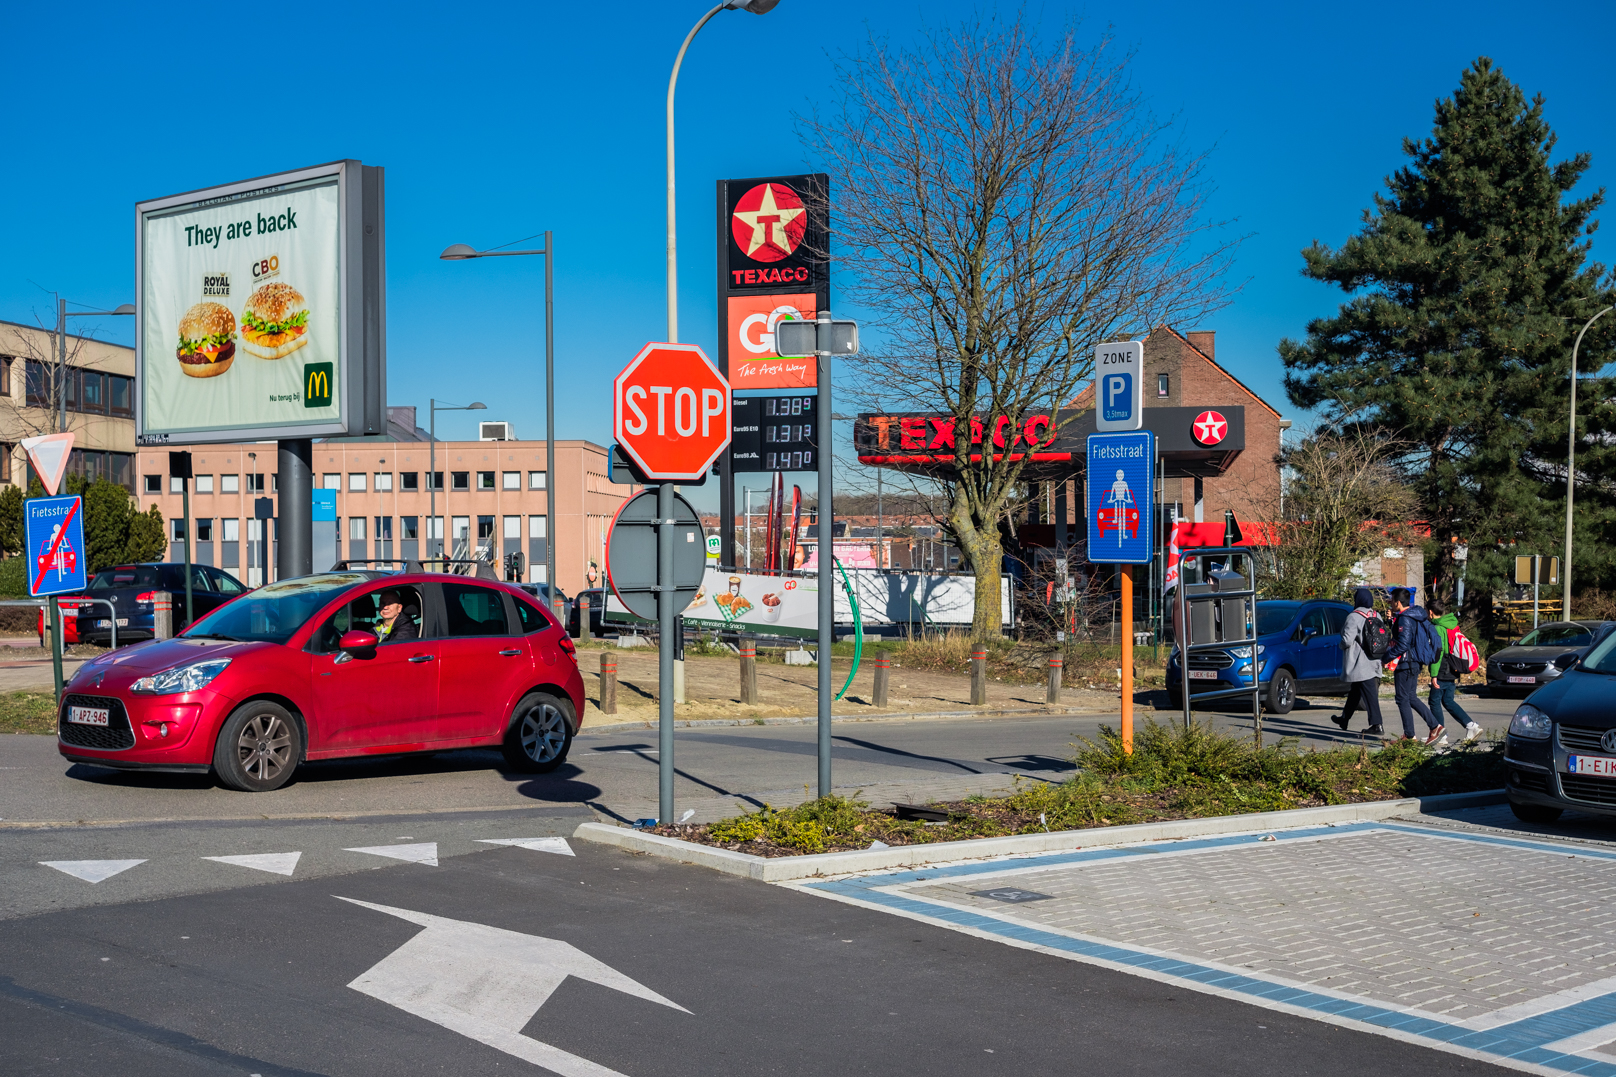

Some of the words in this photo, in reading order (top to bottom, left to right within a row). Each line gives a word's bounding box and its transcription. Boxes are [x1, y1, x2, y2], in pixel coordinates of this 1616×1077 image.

[184, 222, 222, 249] They
[226, 220, 252, 240] are
[257, 207, 297, 235] back
[252, 255, 279, 277] CBO
[204, 276, 230, 287] ROYAL
[732, 267, 809, 284] TEXACO
[203, 287, 230, 295] DELUXE
[1103, 351, 1133, 364] ZONE
[737, 363, 756, 377] The
[759, 363, 782, 375] fresh
[278, 394, 293, 402] terug
[1109, 376, 1126, 407] P
[624, 384, 724, 437] STOP
[868, 414, 1058, 450] TEXACO
[1093, 444, 1144, 459] Fietsstraat
[31, 505, 77, 518] Fietsstra
[701, 620, 726, 628] Viennoiserie
[72, 708, 107, 724] 1-APZ-946
